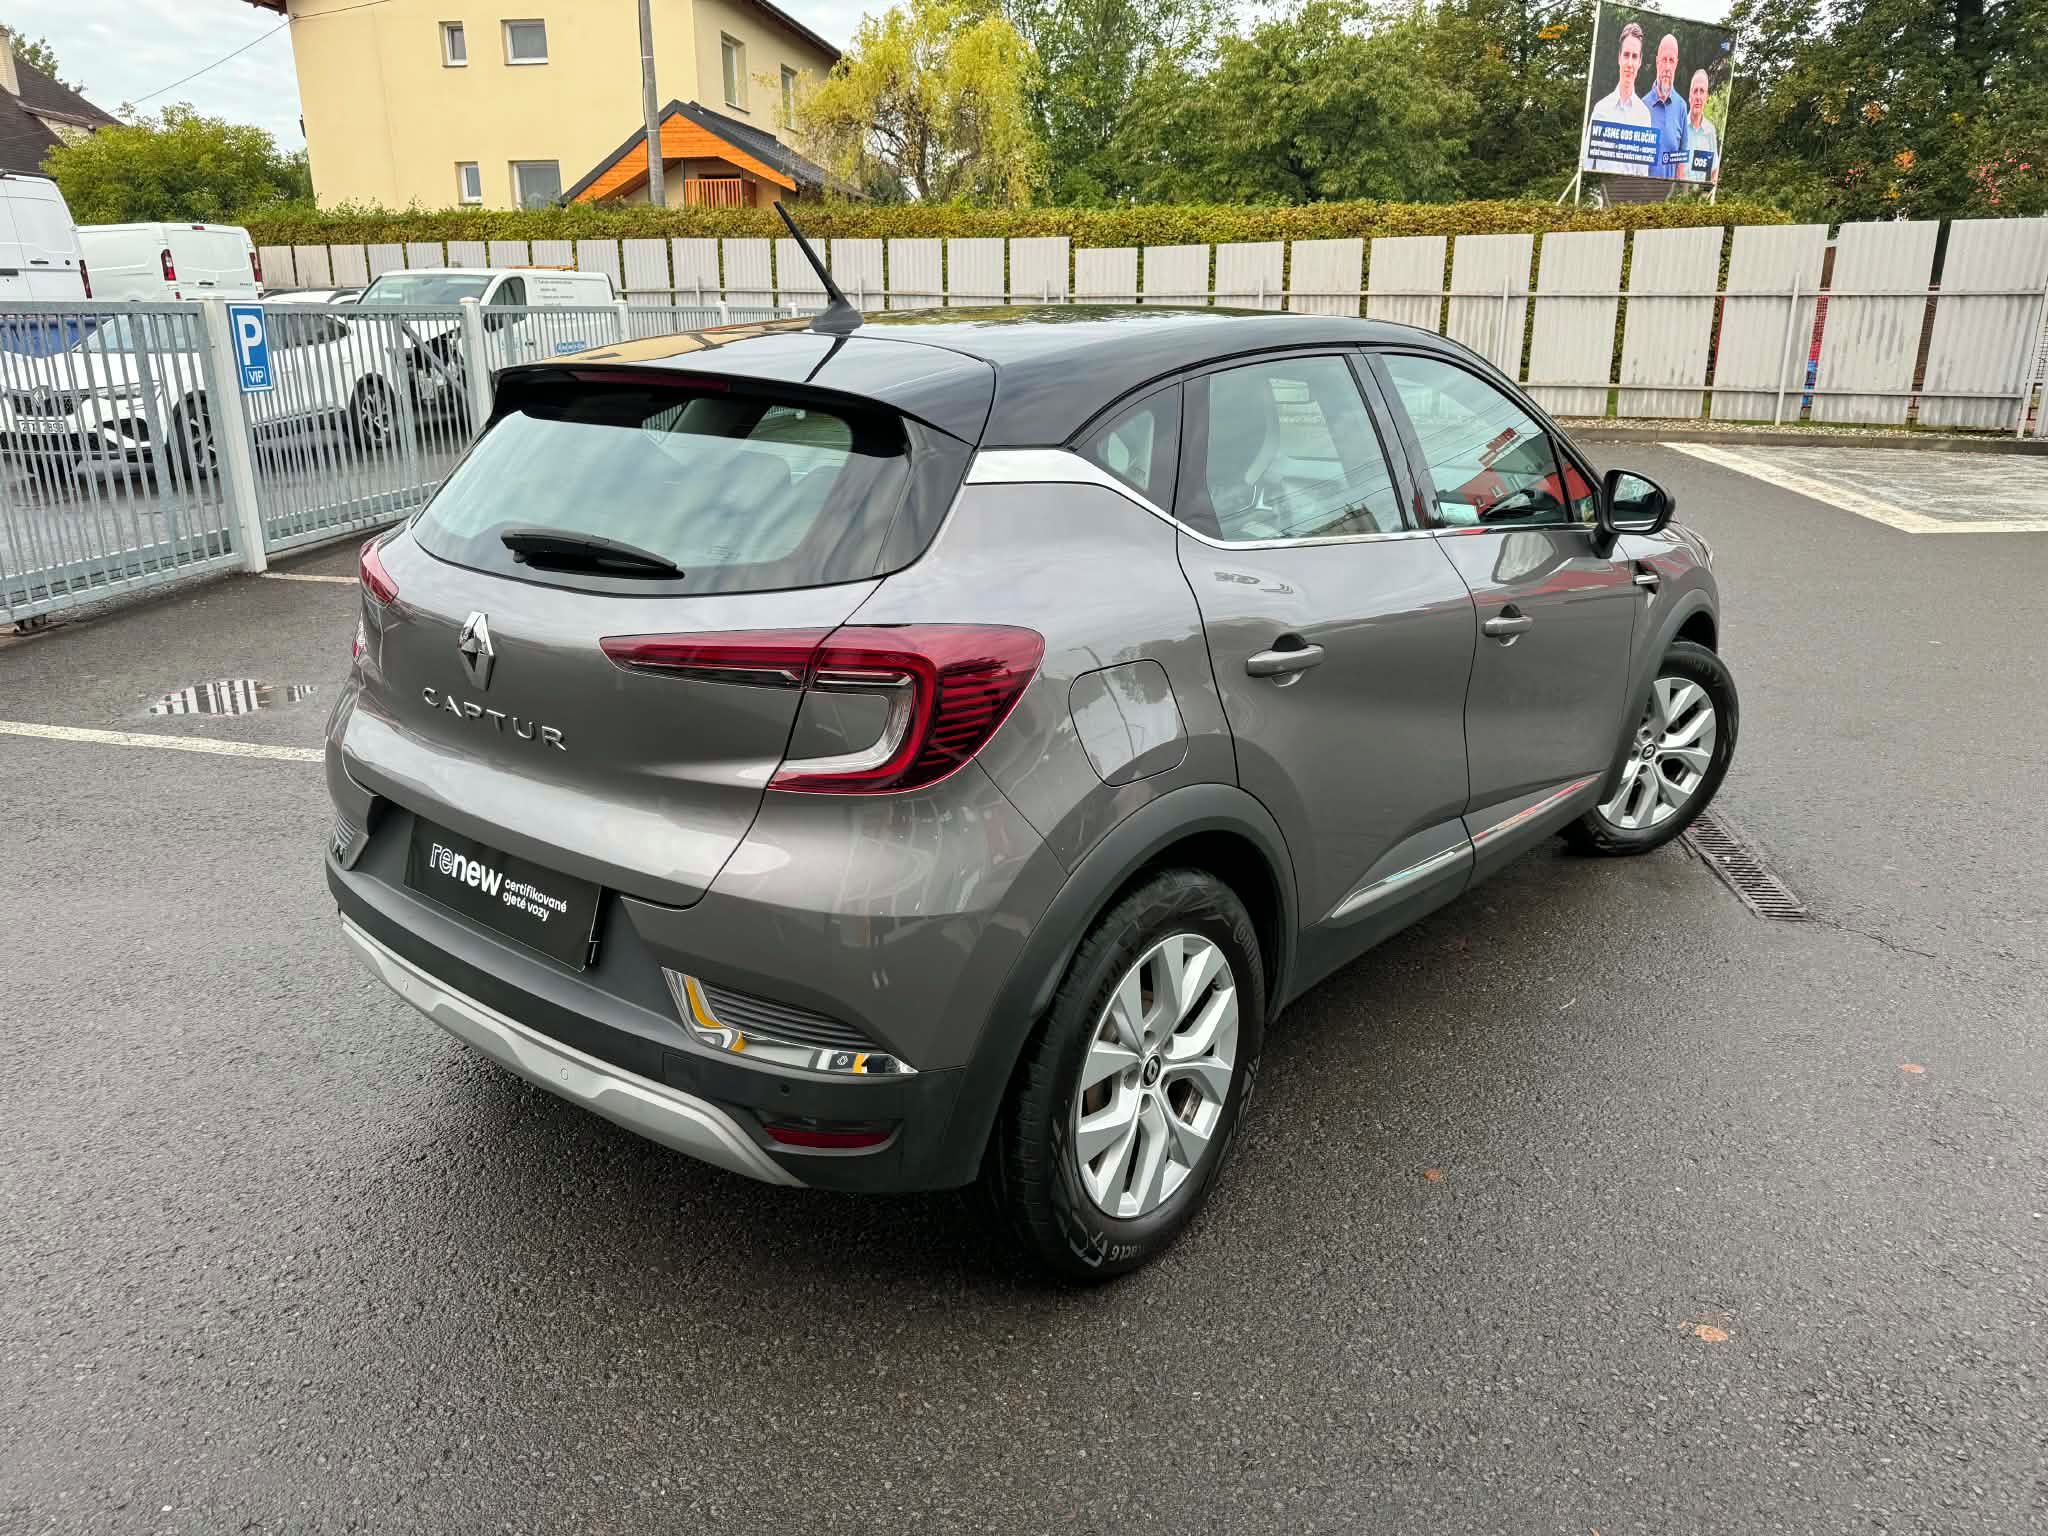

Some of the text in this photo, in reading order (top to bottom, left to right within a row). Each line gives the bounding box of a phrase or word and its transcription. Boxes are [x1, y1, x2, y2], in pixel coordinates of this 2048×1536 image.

[1592, 125, 1602, 137] MY
[1603, 127, 1620, 139] JSME
[1694, 157, 1708, 168] ODS
[236, 314, 263, 366] P
[248, 370, 264, 384] VIP
[422, 687, 568, 752] CAPTUR
[429, 842, 503, 897] renew
[502, 891, 550, 922] ojeté vozy
[504, 878, 567, 913] certifikované
